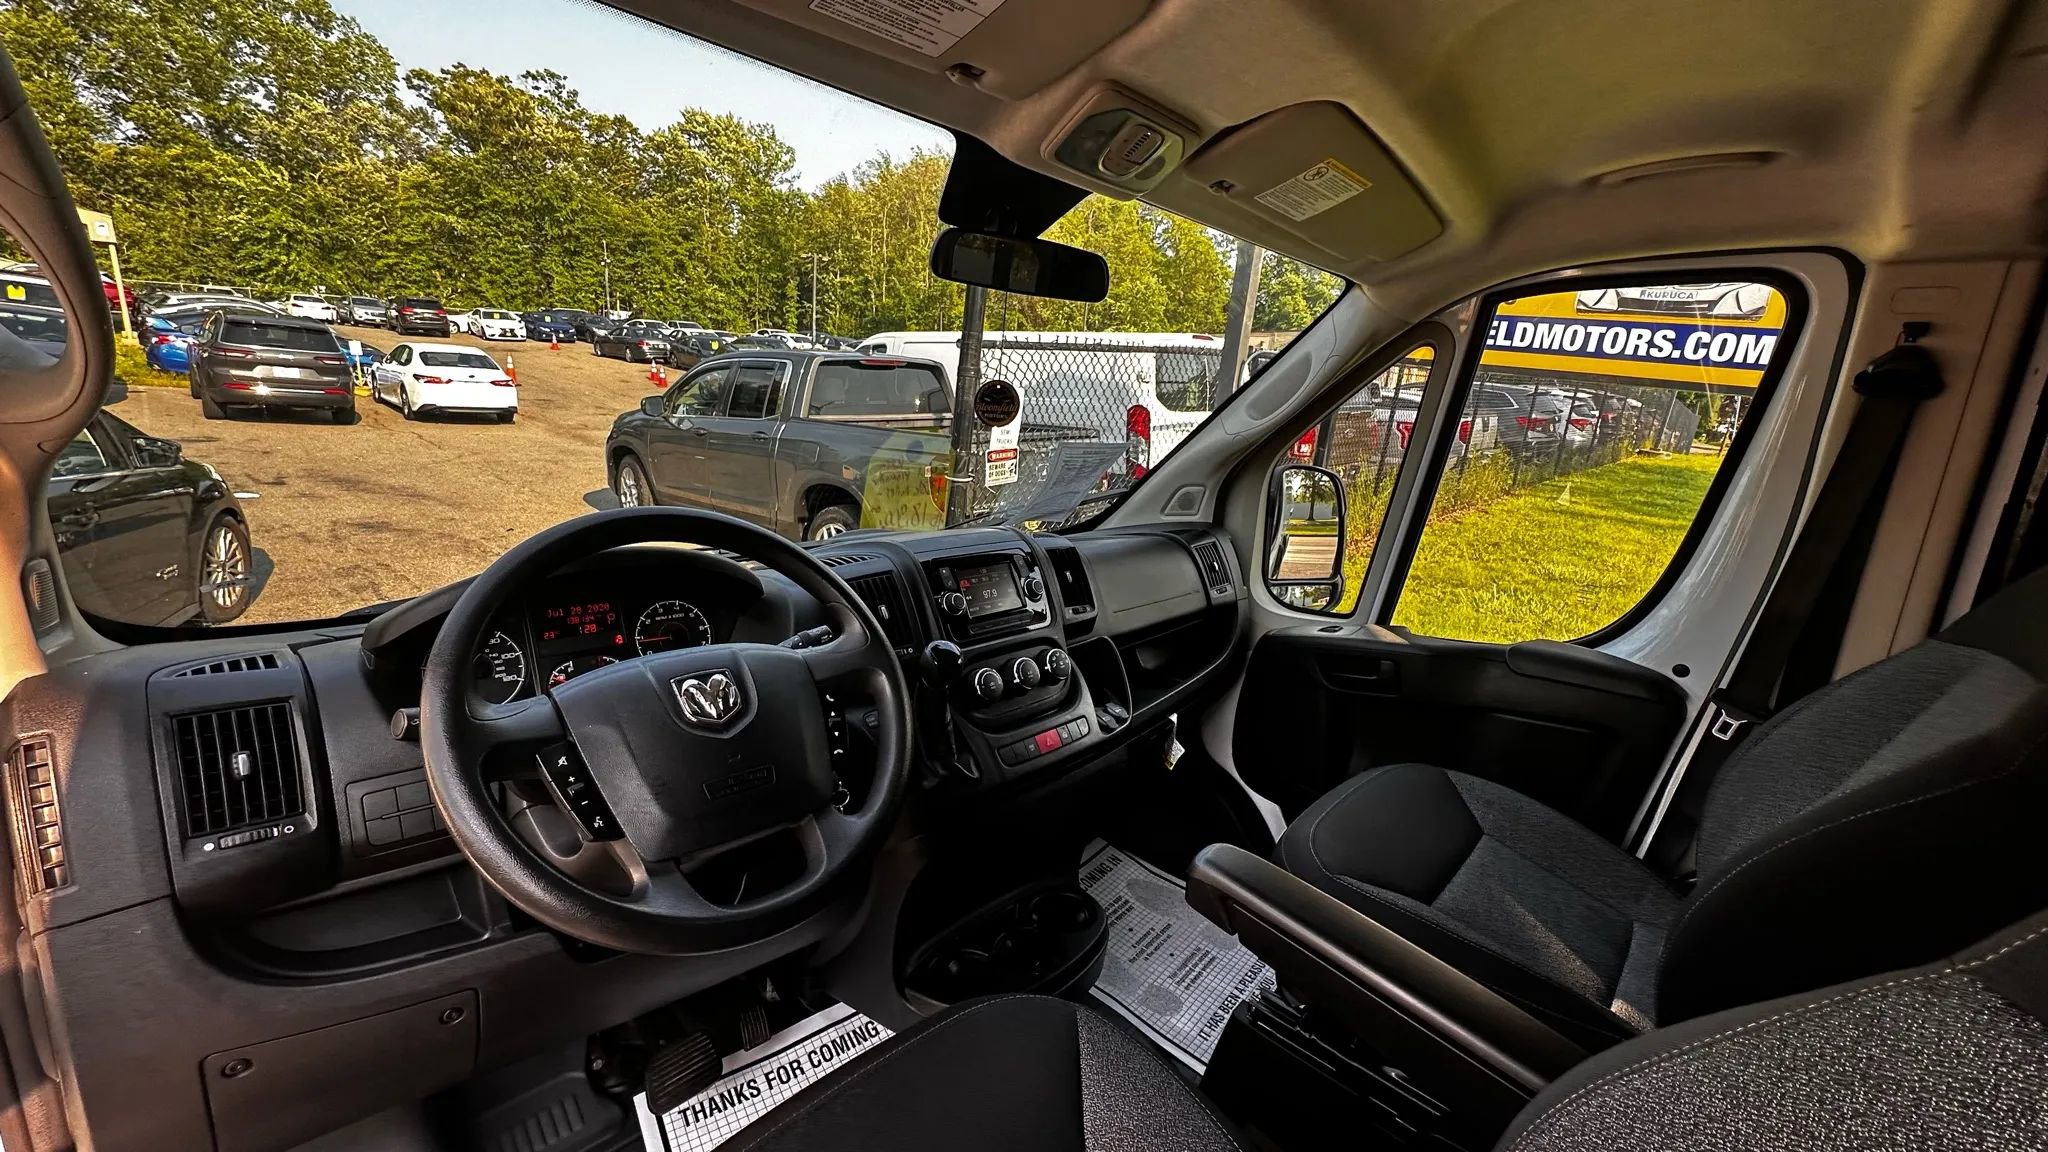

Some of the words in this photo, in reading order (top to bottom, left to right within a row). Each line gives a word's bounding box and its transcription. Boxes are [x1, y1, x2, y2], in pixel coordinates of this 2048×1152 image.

[1486, 320, 1778, 365] ELDMOTORS.COM
[982, 588, 998, 599] 97.9
[548, 608, 564, 618] Jul
[587, 602, 610, 613] 2020
[1106, 854, 1124, 867] IN
[1198, 1028, 1211, 1042] IT
[1206, 1011, 1225, 1032] HAS
[1219, 992, 1241, 1015] BEEN
[1235, 984, 1246, 995] A
[678, 1078, 762, 1128] THANKS
[764, 1059, 805, 1091] FOR
[807, 1020, 881, 1069] COMING
